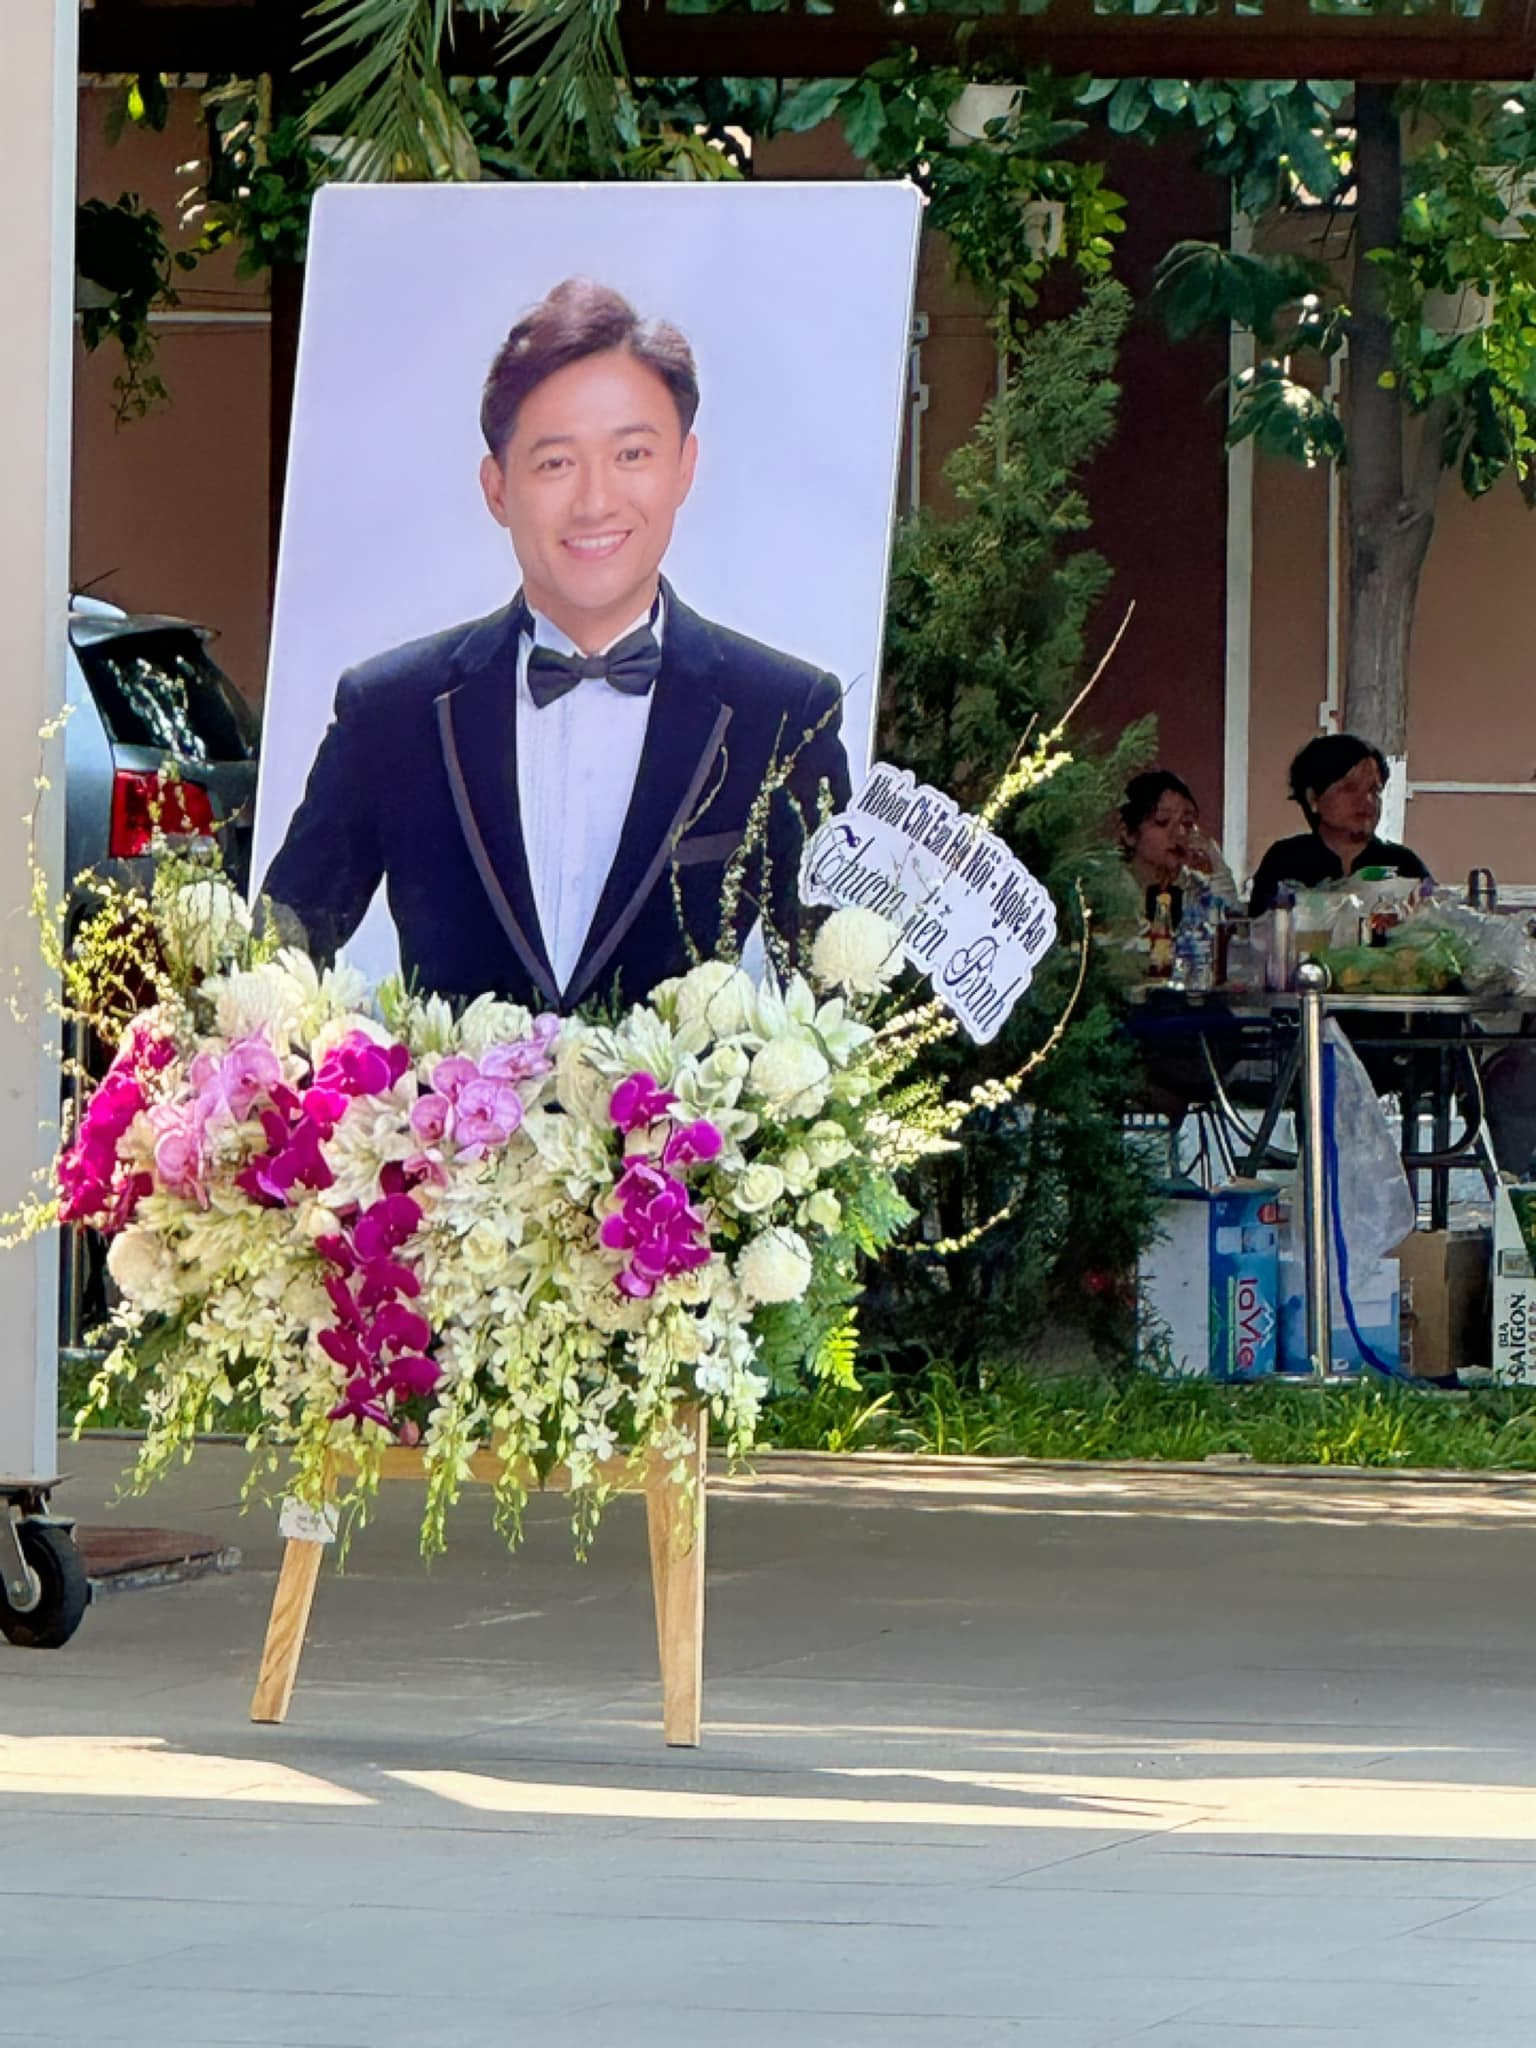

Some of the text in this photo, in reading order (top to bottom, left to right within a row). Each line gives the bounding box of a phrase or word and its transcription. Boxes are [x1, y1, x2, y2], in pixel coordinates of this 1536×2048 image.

[922, 811, 952, 856] Em
[960, 842, 1002, 896] Nội
[1019, 908, 1047, 955] An
[1510, 1294, 1527, 1379] SAIGON
